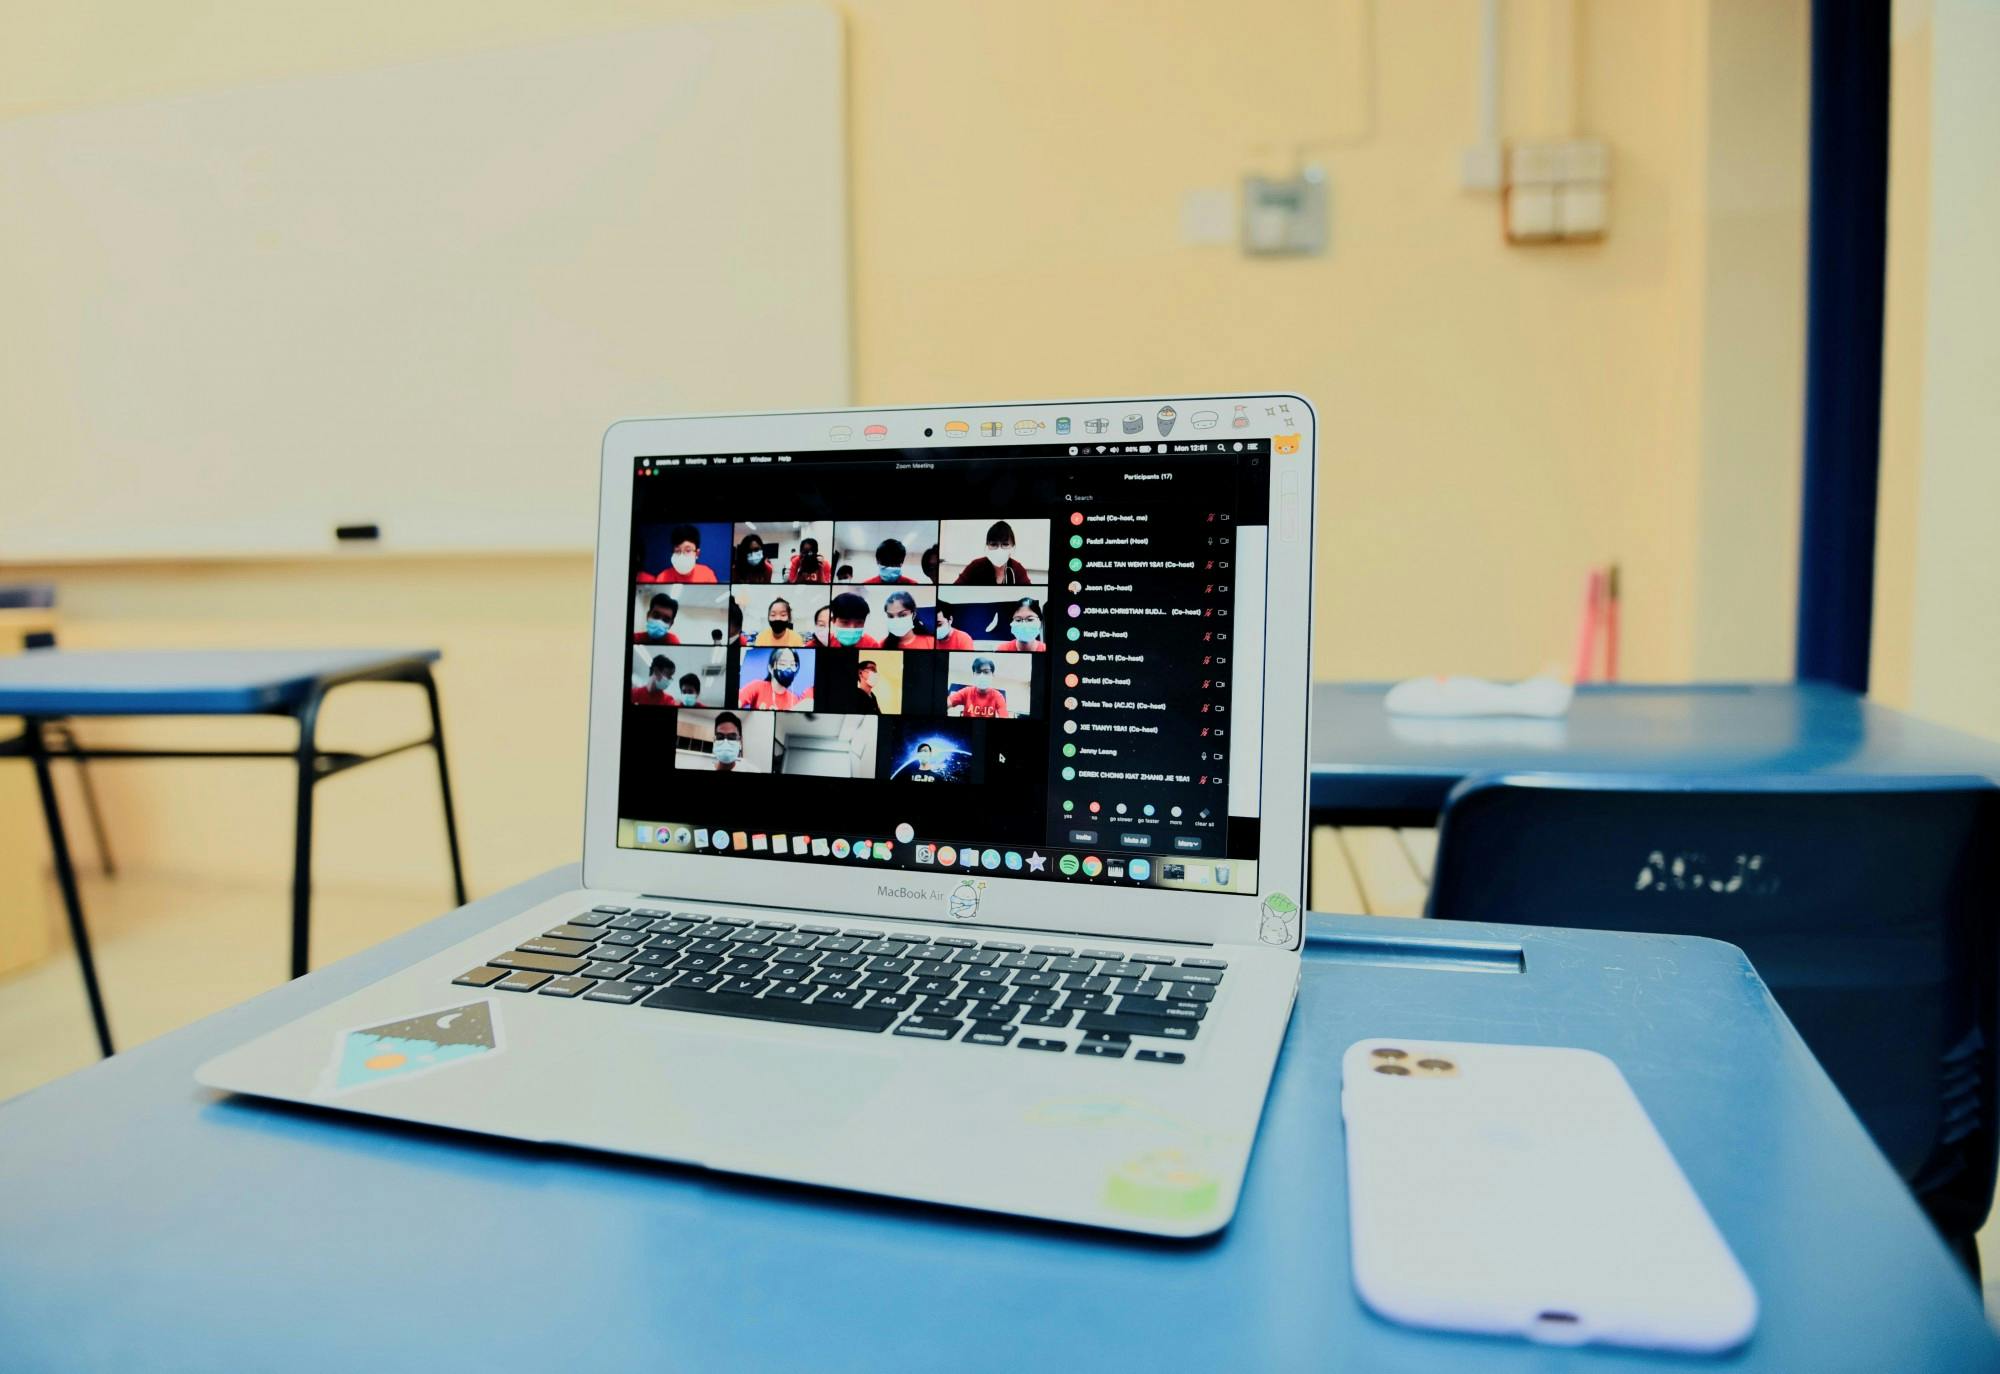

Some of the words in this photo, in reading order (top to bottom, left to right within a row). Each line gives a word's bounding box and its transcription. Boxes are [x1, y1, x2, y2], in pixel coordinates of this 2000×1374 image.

[1174, 444, 1189, 452] Mon
[713, 457, 726, 465] View
[733, 456, 744, 464] Edit
[750, 455, 772, 463] Window
[778, 455, 791, 463] Help
[896, 462, 911, 470] Zoom
[912, 461, 935, 470] Meeting
[1124, 473, 1159, 481] Participants
[1161, 472, 1172, 481] (17)
[1107, 514, 1134, 523] (Co-host,
[1130, 537, 1148, 546] (Host)
[1086, 560, 1112, 569] JANELLE
[1114, 560, 1126, 568] TAN
[1165, 560, 1194, 569] (Co-host)
[1104, 584, 1132, 593] (Co-host)
[1083, 607, 1109, 615] JOSHUA
[1110, 607, 1144, 615] CHRISTIAN
[1172, 608, 1201, 617] (Co-host)
[1099, 630, 1128, 639] (Co-host)
[1083, 653, 1095, 663] Ong
[1096, 653, 1106, 661] Xin
[1107, 654, 1114, 662] Yi
[1115, 654, 1144, 663] (Co-host)
[1102, 677, 1131, 687] (Co-host)
[967, 703, 994, 716] ACJC
[1114, 701, 1135, 710] (ACJC)
[1137, 701, 1166, 711] (Co-host)
[1080, 723, 1090, 731] XIE
[1091, 723, 1112, 732] TIANYI
[1129, 725, 1158, 735] (Co-host)
[1079, 770, 1099, 778] DEREK
[1140, 773, 1164, 782] ZHANG
[1165, 774, 1174, 782] JIE
[877, 885, 928, 900] MacBook
[930, 889, 944, 901] Air
[883, 960, 896, 968] U
[926, 982, 939, 990] K
[832, 991, 847, 999] N
[880, 996, 897, 1005] M
